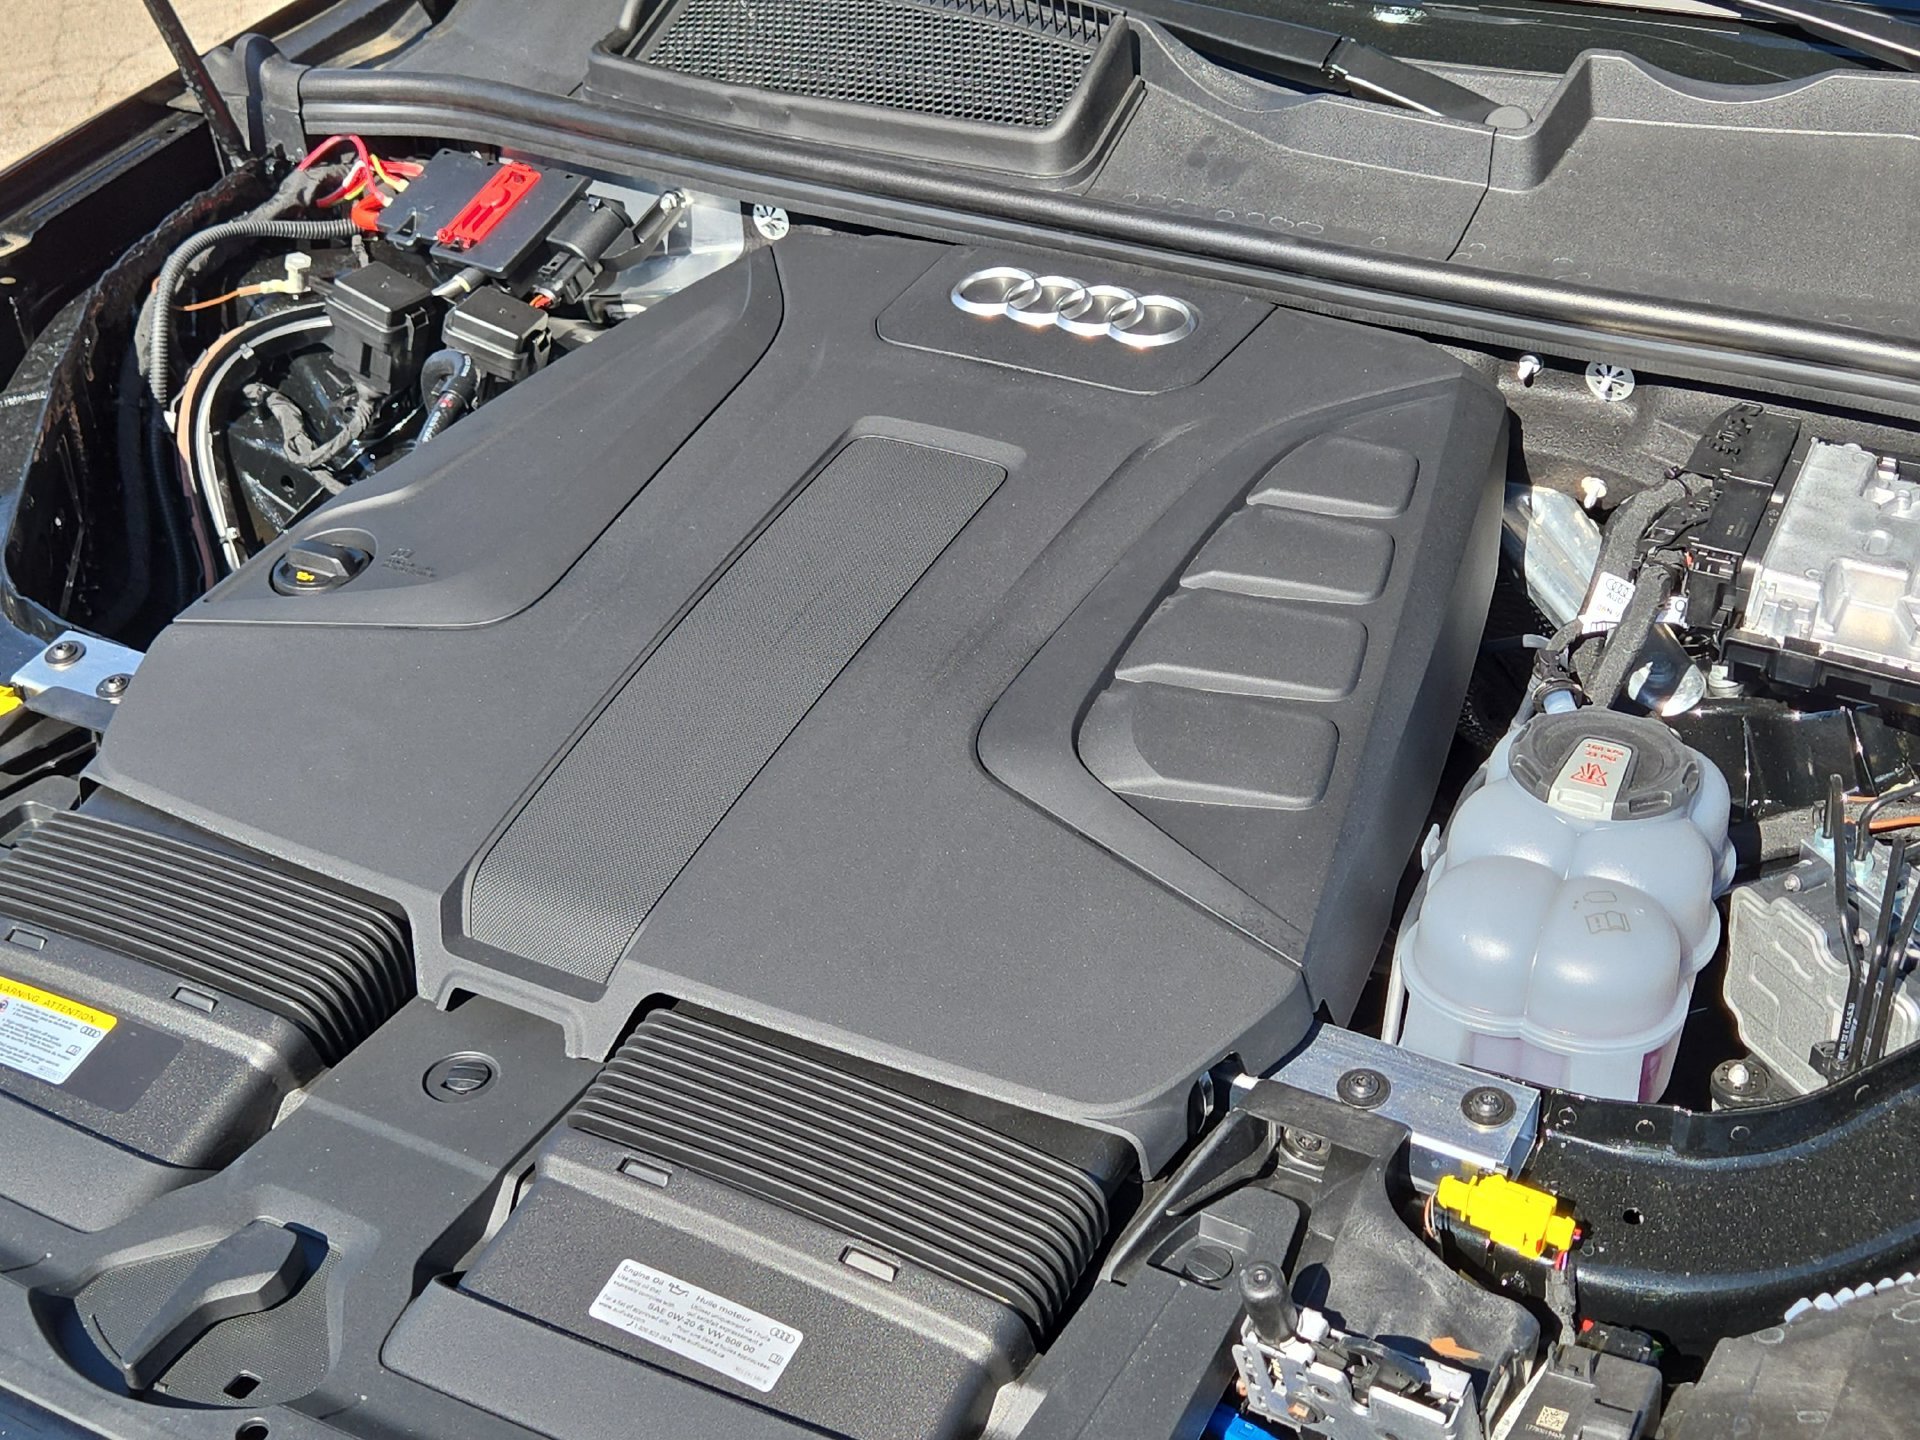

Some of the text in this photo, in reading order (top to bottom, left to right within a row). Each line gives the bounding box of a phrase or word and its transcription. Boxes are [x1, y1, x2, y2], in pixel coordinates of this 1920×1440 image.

[44, 1000, 96, 1023] ATTENTION
[622, 1264, 665, 1286] Engine Oil
[695, 1295, 752, 1323] Huile moteur
[647, 1302, 756, 1353] SAE 0W-20 & VW 508 00
